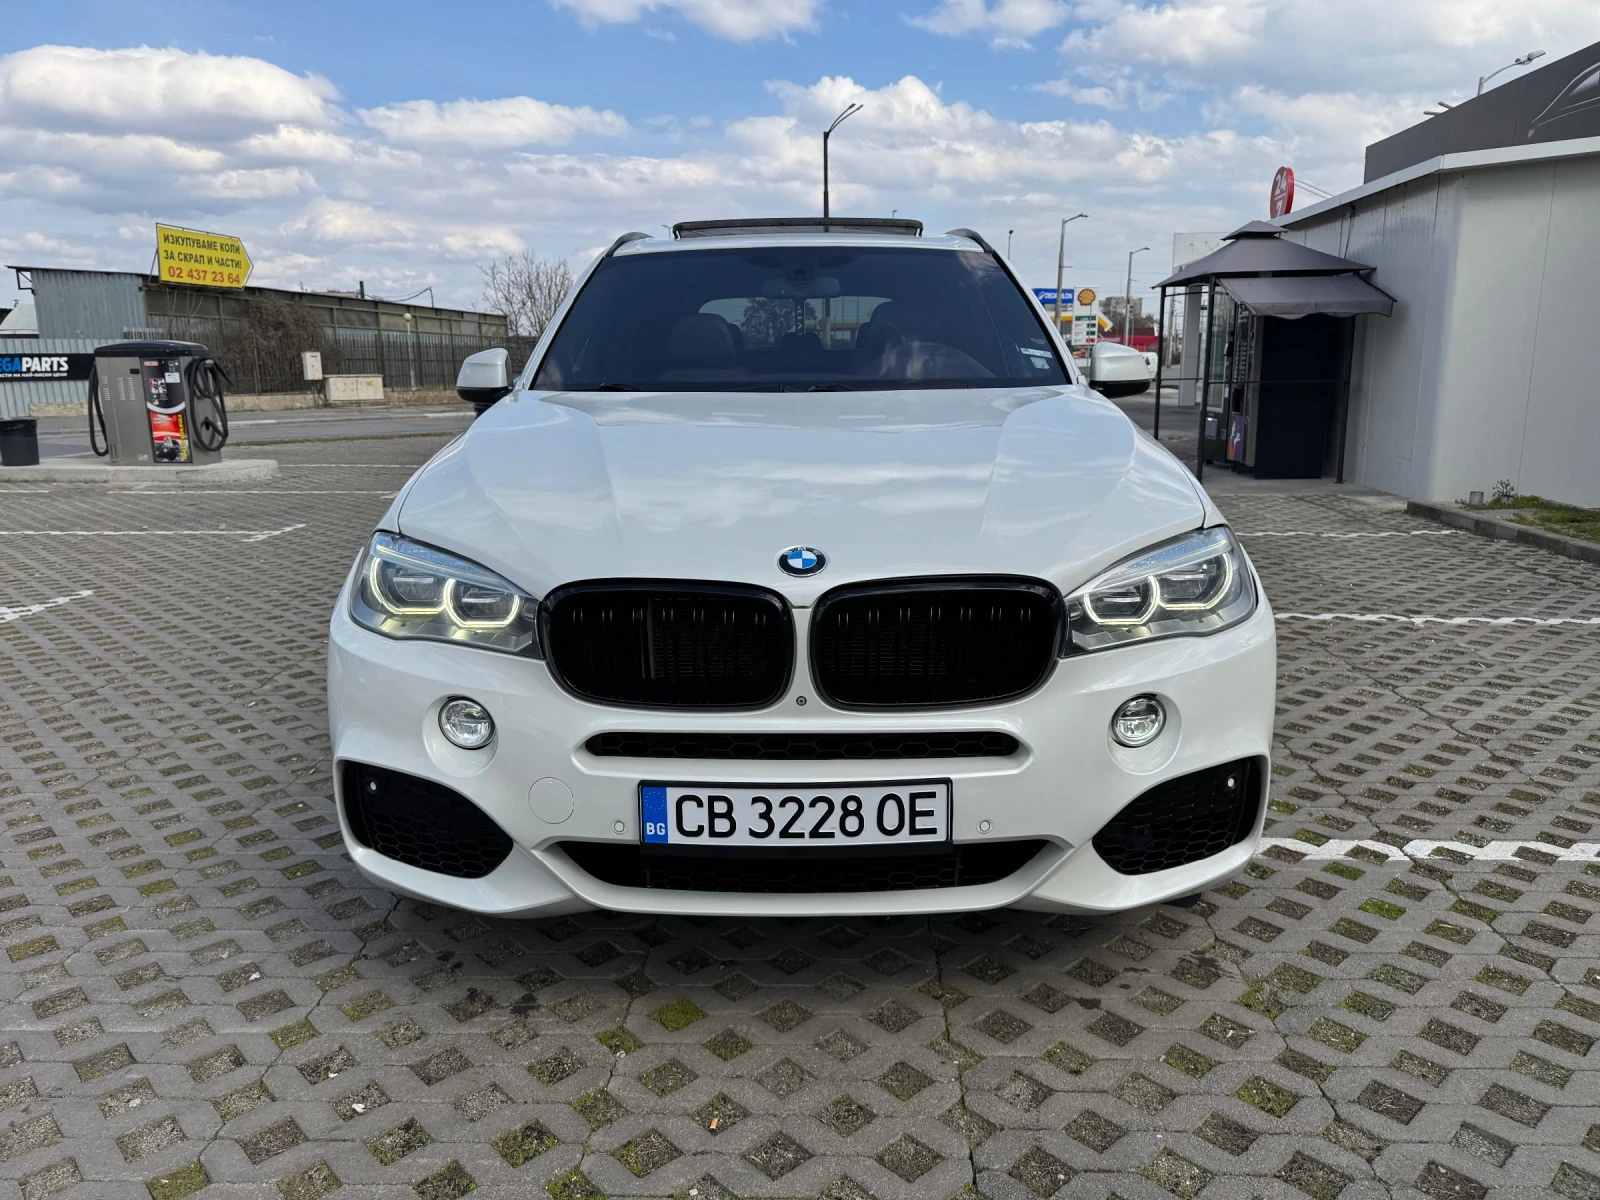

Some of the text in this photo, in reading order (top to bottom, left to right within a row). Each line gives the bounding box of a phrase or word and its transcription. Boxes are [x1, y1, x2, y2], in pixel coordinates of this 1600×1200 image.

[1275, 170, 1287, 196] 24
[163, 233, 241, 254] ИЗКУПУВАМЕ КОЛИ
[163, 250, 242, 269] ЗА СКРАП И ЧАСТИ!
[168, 266, 240, 284] 02 437 23 64
[1045, 292, 1073, 300] DECALON
[645, 791, 938, 839] BG CB 3228 OE
